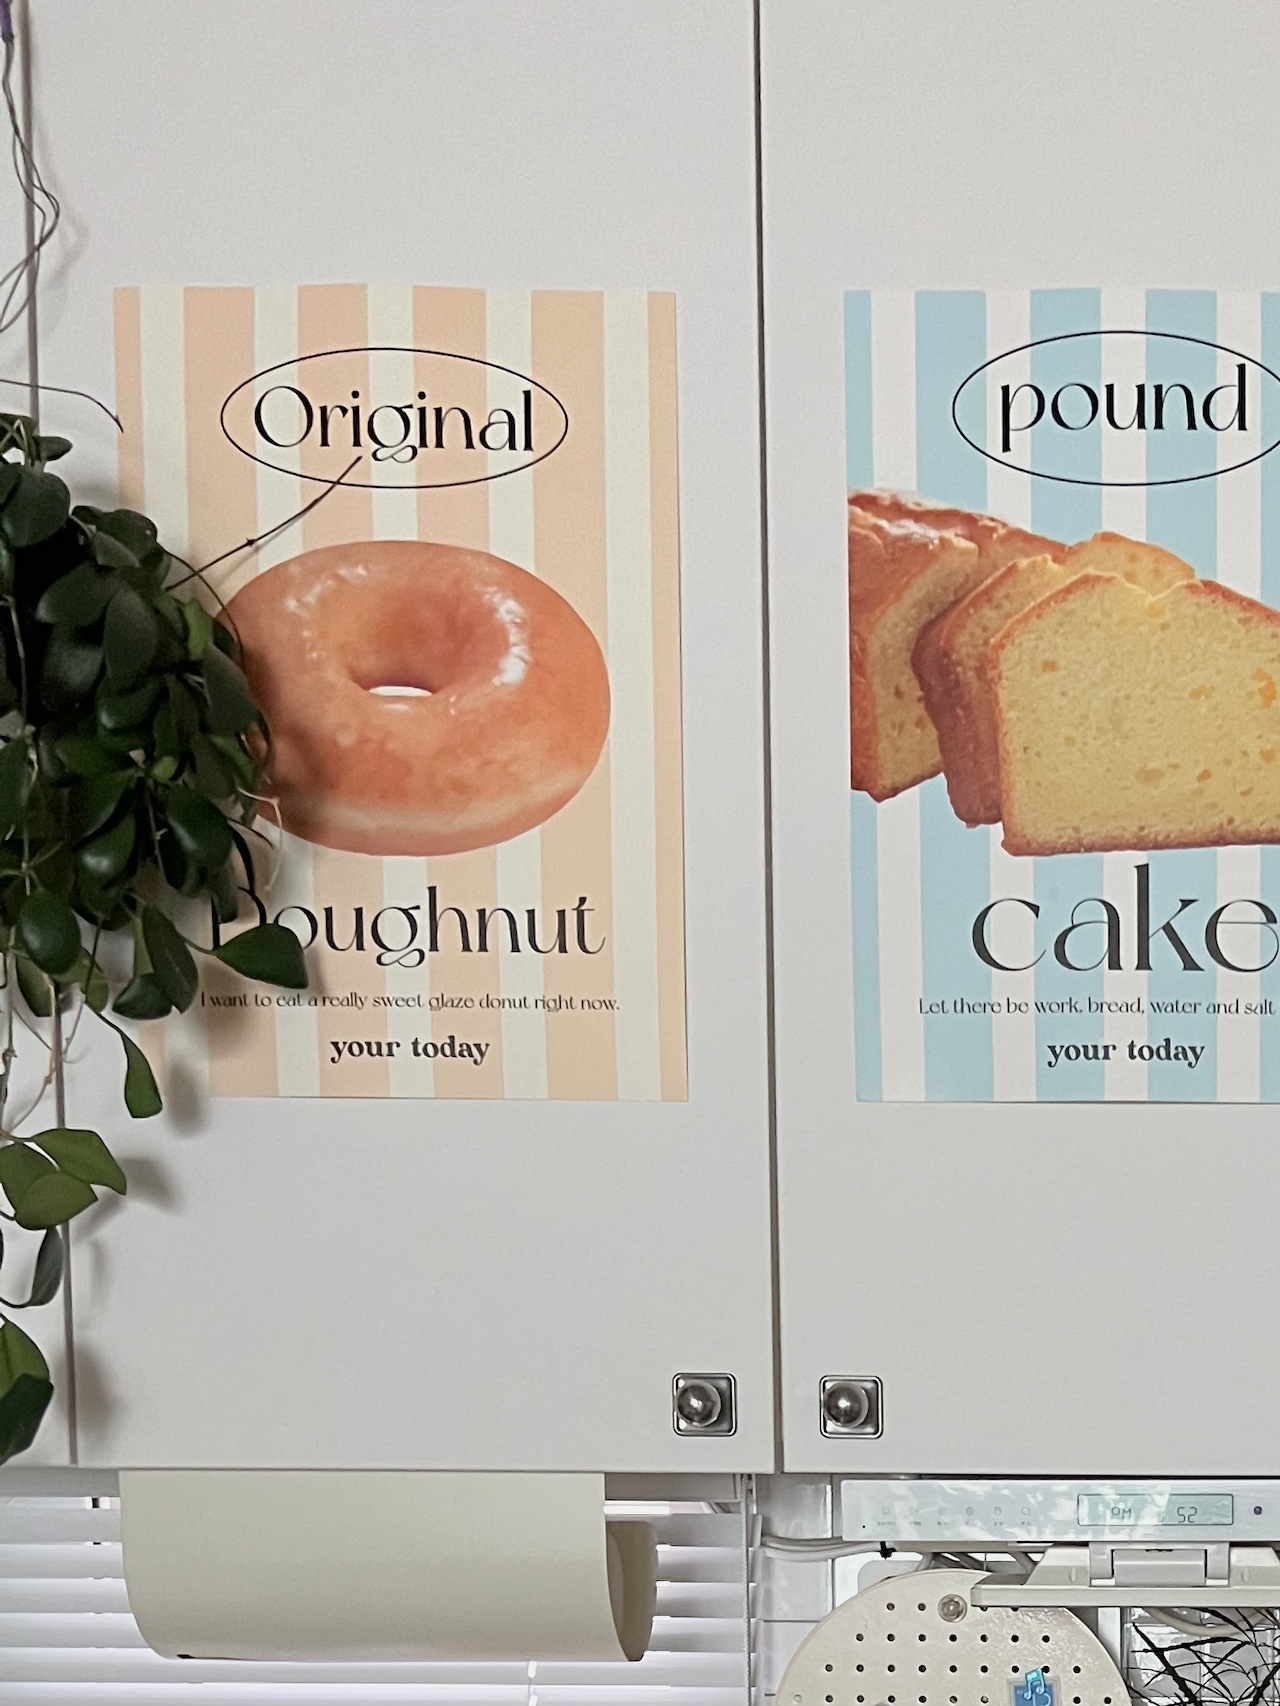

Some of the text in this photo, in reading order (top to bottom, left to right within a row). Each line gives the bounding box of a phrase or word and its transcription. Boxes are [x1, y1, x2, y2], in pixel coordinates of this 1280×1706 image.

[1000, 363, 1248, 453] pound
[254, 385, 534, 464] Original
[971, 862, 1280, 973] cake
[210, 991, 249, 1008] want
[254, 992, 272, 1008] to
[276, 992, 305, 1008] eat
[307, 995, 318, 1008] a
[322, 991, 368, 1011] really
[372, 993, 425, 1009] sweet
[428, 993, 476, 1012] glaze
[479, 994, 531, 1010] donut
[535, 995, 578, 1013] right
[581, 998, 621, 1011] now.
[919, 997, 949, 1015] Let
[953, 997, 1003, 1015] there
[1006, 997, 1030, 1014] be
[1150, 999, 1202, 1015] water
[1206, 998, 1240, 1015] and
[1244, 998, 1277, 1016] salt
[330, 1034, 490, 1066] your today
[1047, 1037, 1206, 1069] your today
